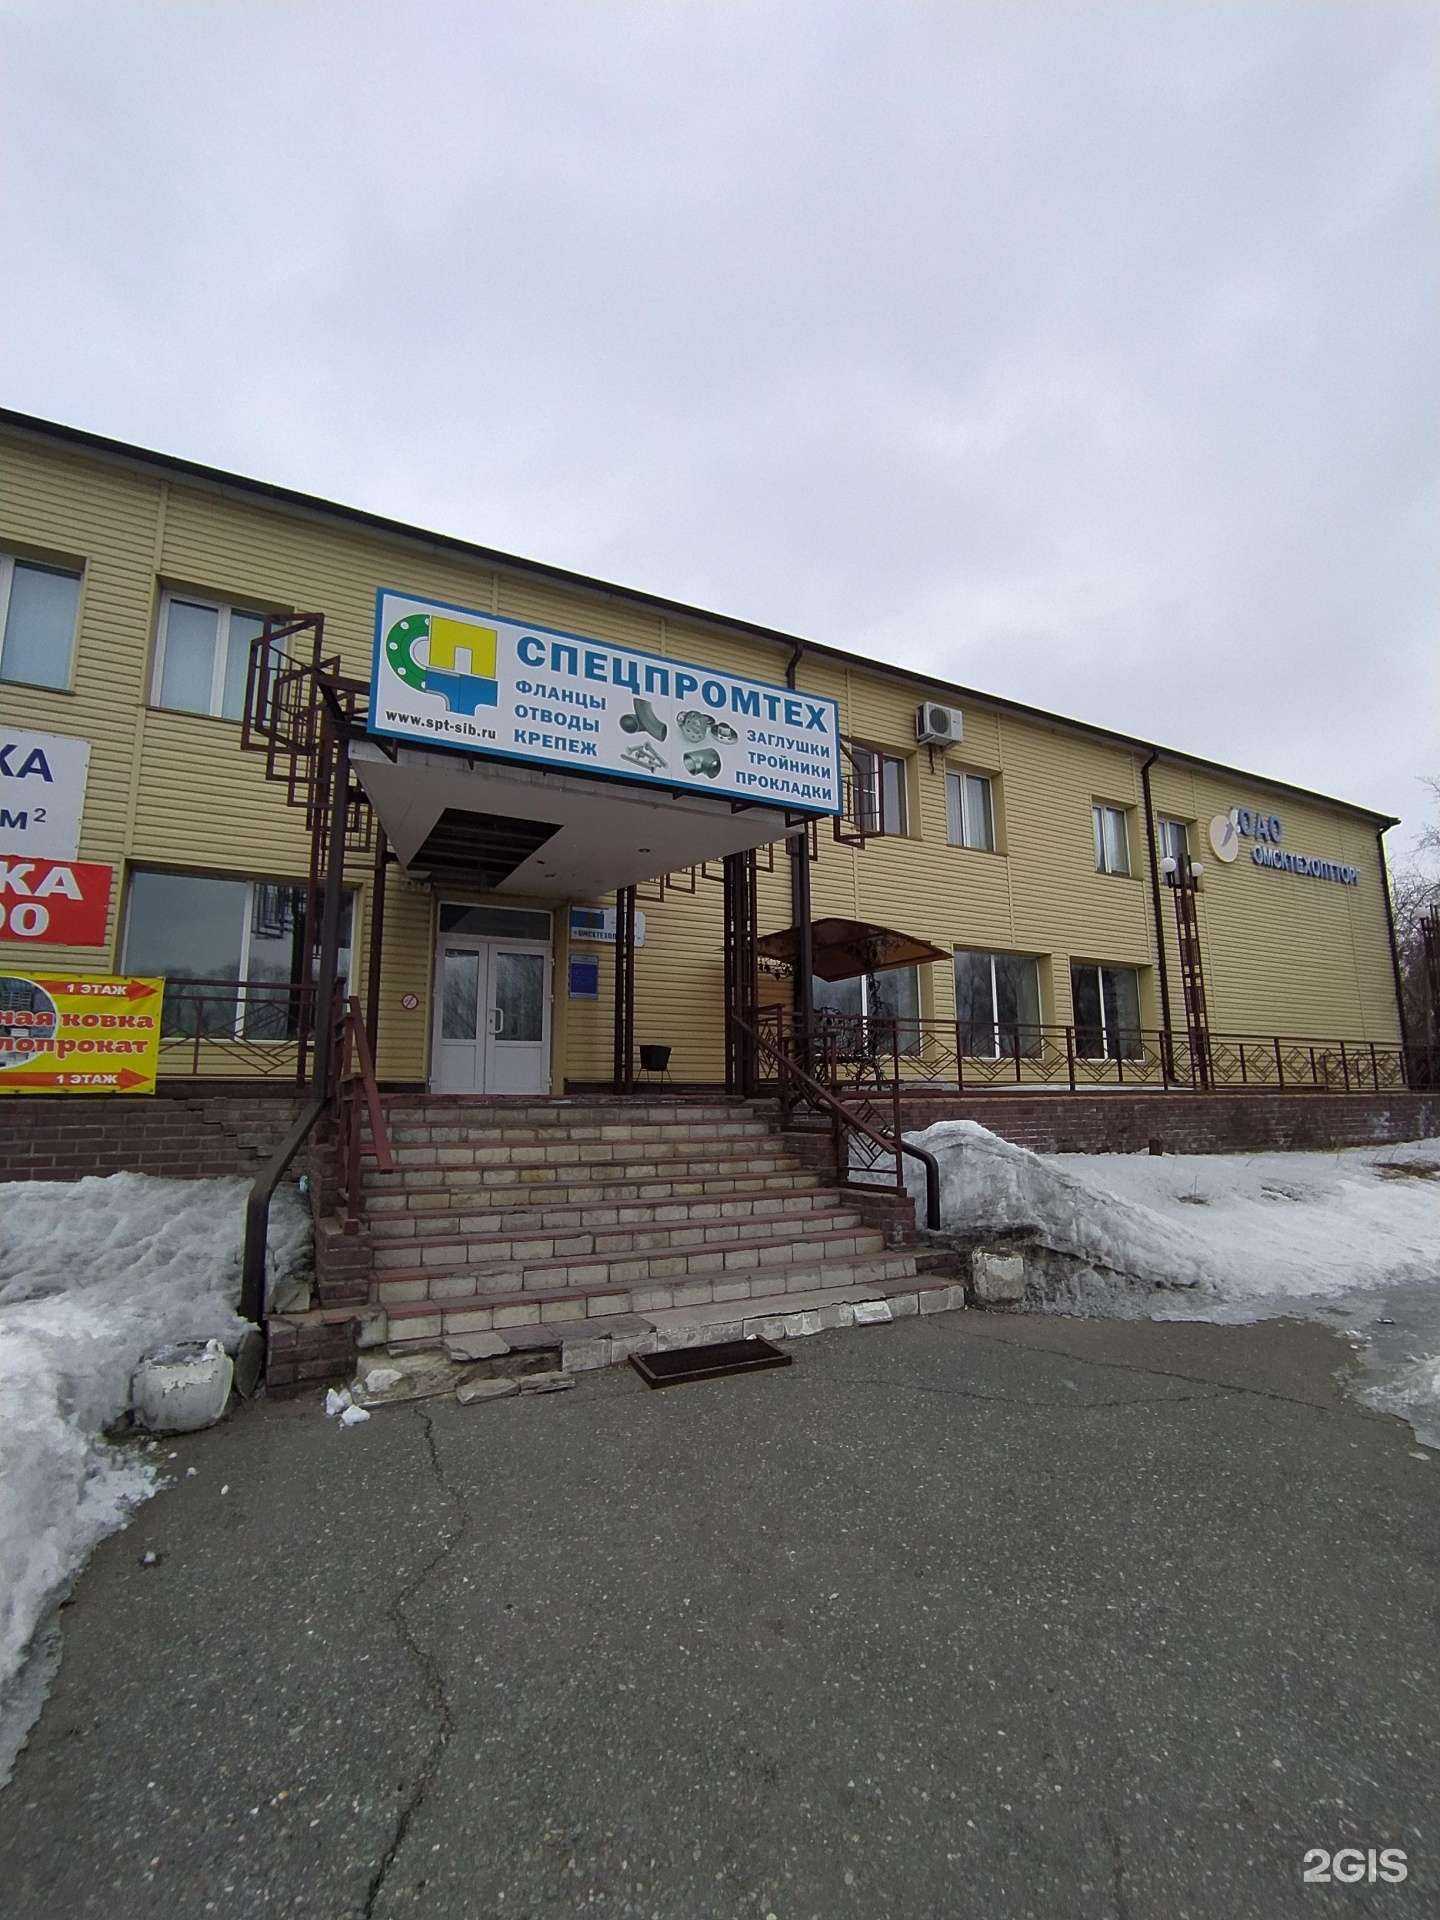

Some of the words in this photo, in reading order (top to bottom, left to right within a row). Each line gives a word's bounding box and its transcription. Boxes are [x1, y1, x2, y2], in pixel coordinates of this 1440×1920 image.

[515, 680, 607, 711] ФЛАНЦЫ
[516, 636, 828, 734] СПЕЦПРОМТЕХ
[385, 710, 497, 740] www.spt-sib.ru
[514, 705, 599, 733] ОТВОДЫ
[514, 729, 598, 757] КРЕПЕЖ
[747, 729, 830, 759] ЗАГЛУШКИ
[748, 751, 831, 780] ТРОЙНИКИ
[735, 771, 832, 801] ПРОКЛАДКИ
[1238, 808, 1281, 843] ОАО
[66, 984, 74, 993] 1
[80, 984, 127, 995] ЭТАЖ
[60, 1012, 155, 1030] ковка
[56, 1075, 64, 1084] 1
[70, 1074, 118, 1085] ЭТАЖ
